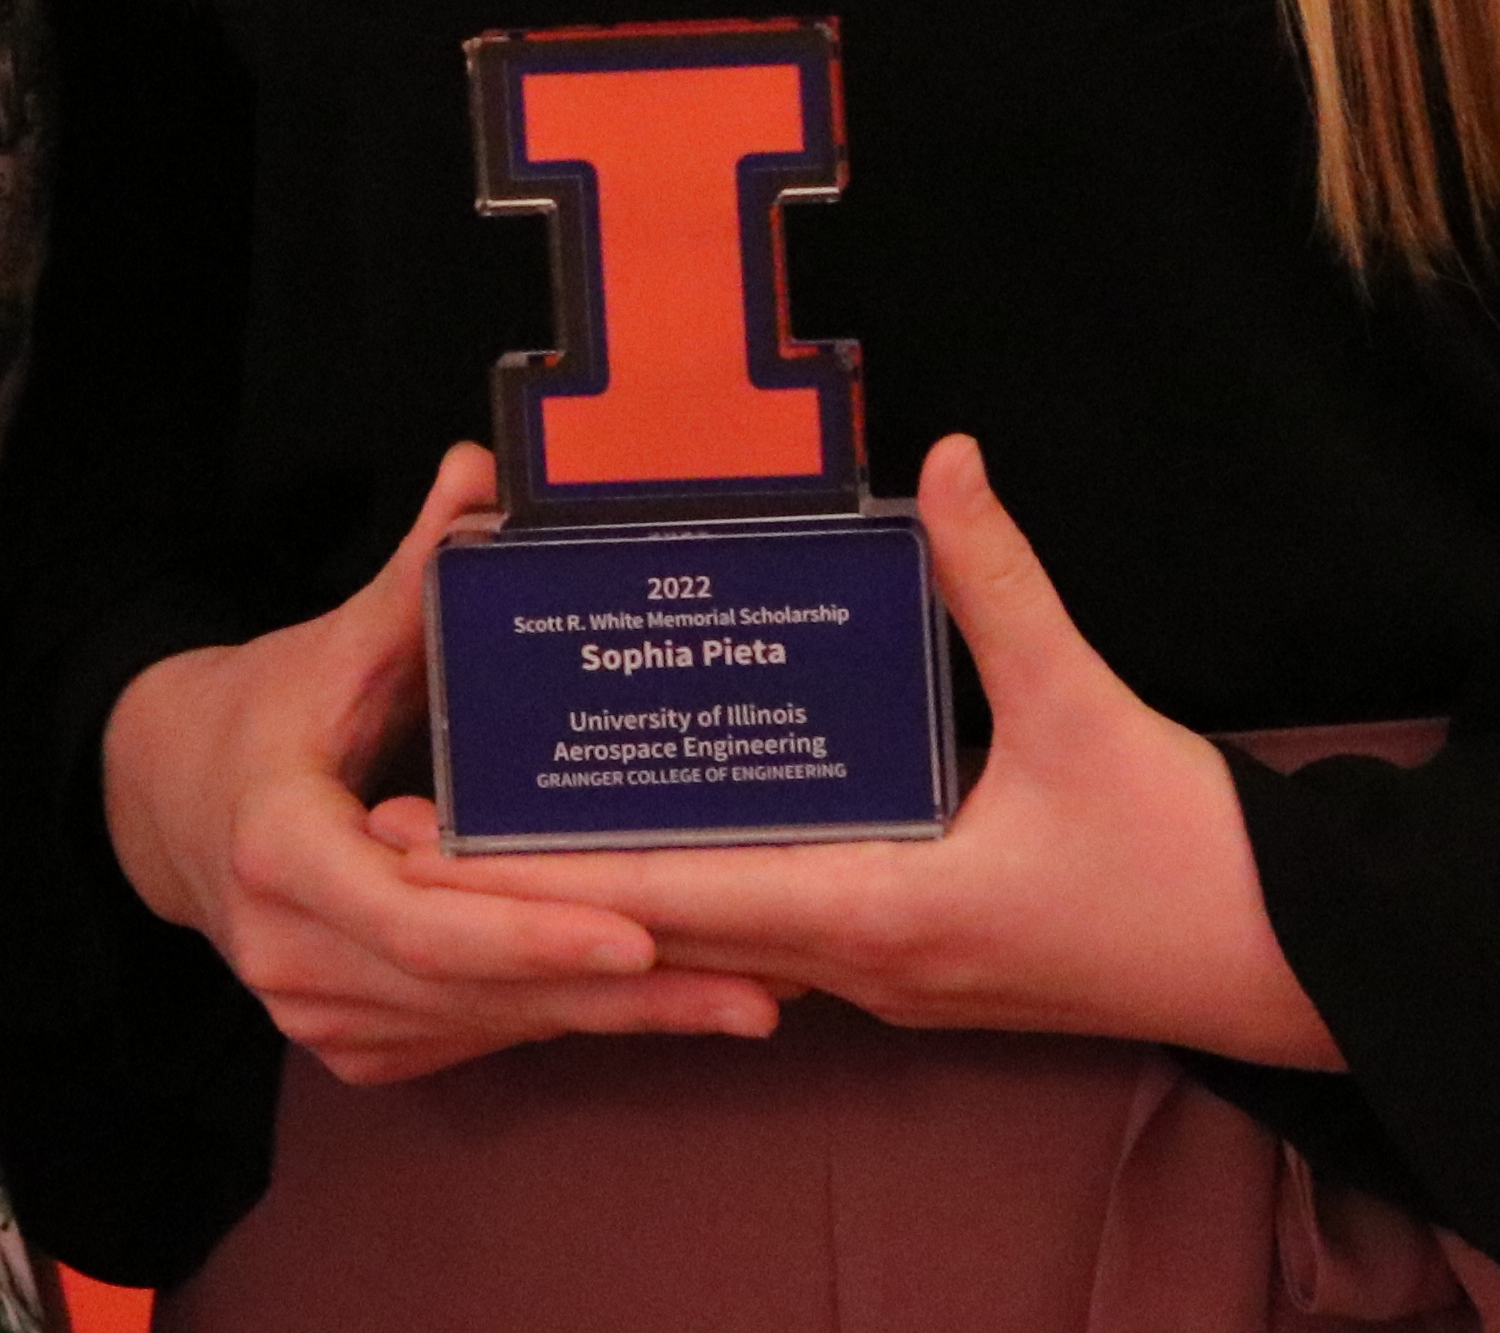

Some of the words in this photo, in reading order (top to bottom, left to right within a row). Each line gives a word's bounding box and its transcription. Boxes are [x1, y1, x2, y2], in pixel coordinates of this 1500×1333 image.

[506, 50, 845, 501] I
[647, 575, 713, 600] 2022
[513, 615, 565, 634] Scott
[567, 614, 587, 631] R.
[589, 611, 644, 631] White
[647, 607, 737, 629] Memorial
[740, 604, 850, 625] Scholarship
[581, 639, 694, 676] Sophia
[703, 637, 787, 667] Pieta
[569, 707, 692, 733] University
[697, 704, 722, 728] of
[727, 702, 808, 727] Illinois
[553, 741, 678, 765] Aerospace
[683, 732, 828, 762] Engineering
[536, 770, 624, 788] GRAINGER
[627, 767, 702, 785] COLLEGE
[705, 766, 728, 783] OF
[732, 763, 848, 782] ENGINEERING
